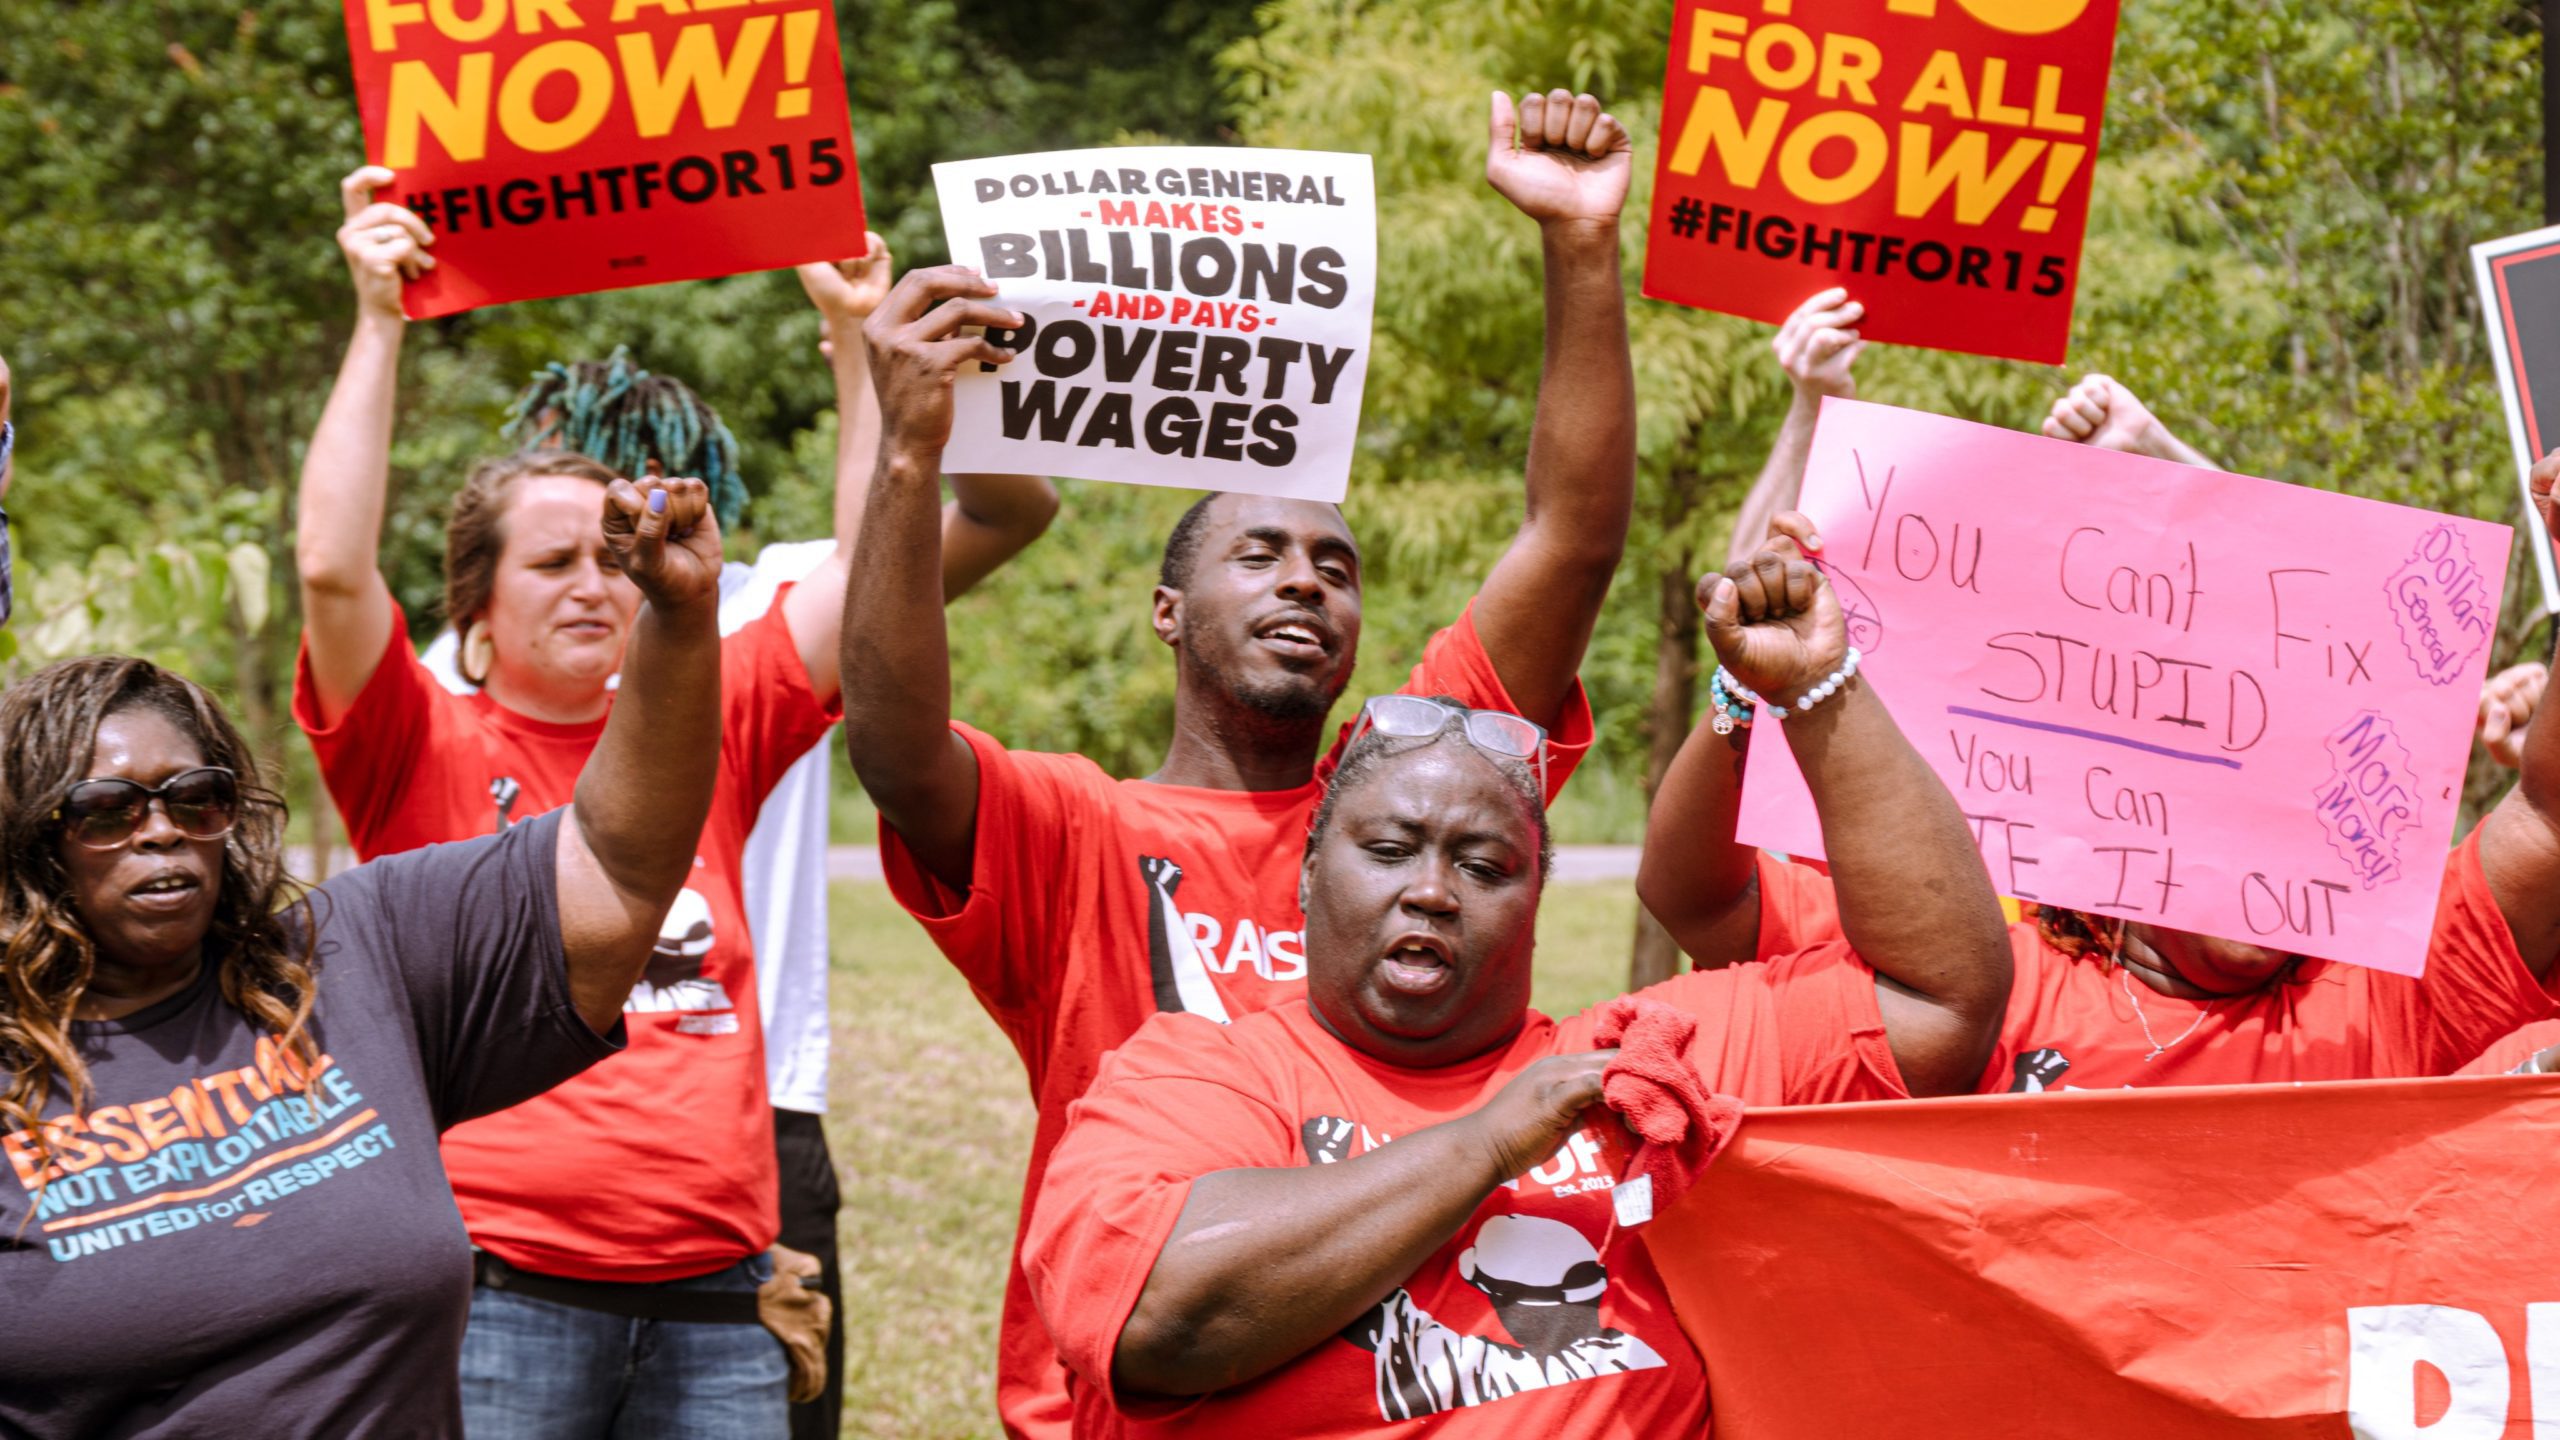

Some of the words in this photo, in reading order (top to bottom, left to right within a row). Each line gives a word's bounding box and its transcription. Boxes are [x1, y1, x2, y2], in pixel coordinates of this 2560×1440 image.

[383, 9, 822, 170] NOW!
[1687, 7, 1883, 106] FOR
[1901, 49, 2087, 135] ALL
[405, 137, 845, 234] #FIGHTFOR15
[974, 168, 1150, 204] DOLLAR
[1155, 168, 1345, 206] GENERAL
[1668, 85, 2088, 234] NOW!
[979, 228, 1348, 309] BILLIONS
[1668, 196, 2067, 297] #FIGHTFOR15
[979, 311, 1355, 404] POVERTY
[1000, 379, 1300, 467] WAGES
[2268, 569, 2372, 686] Fix
[2399, 575, 2456, 671] General
[2423, 528, 2487, 634] Dollar
[1979, 631, 2268, 752] STUPID
[1966, 811, 2040, 900] TE
[2241, 871, 2352, 937] OUT
[2317, 780, 2392, 882] Money
[1184, 912, 1307, 981] RAIS
[28, 1167, 116, 1220] NOT
[119, 1068, 363, 1194] EXPLOITABLE
